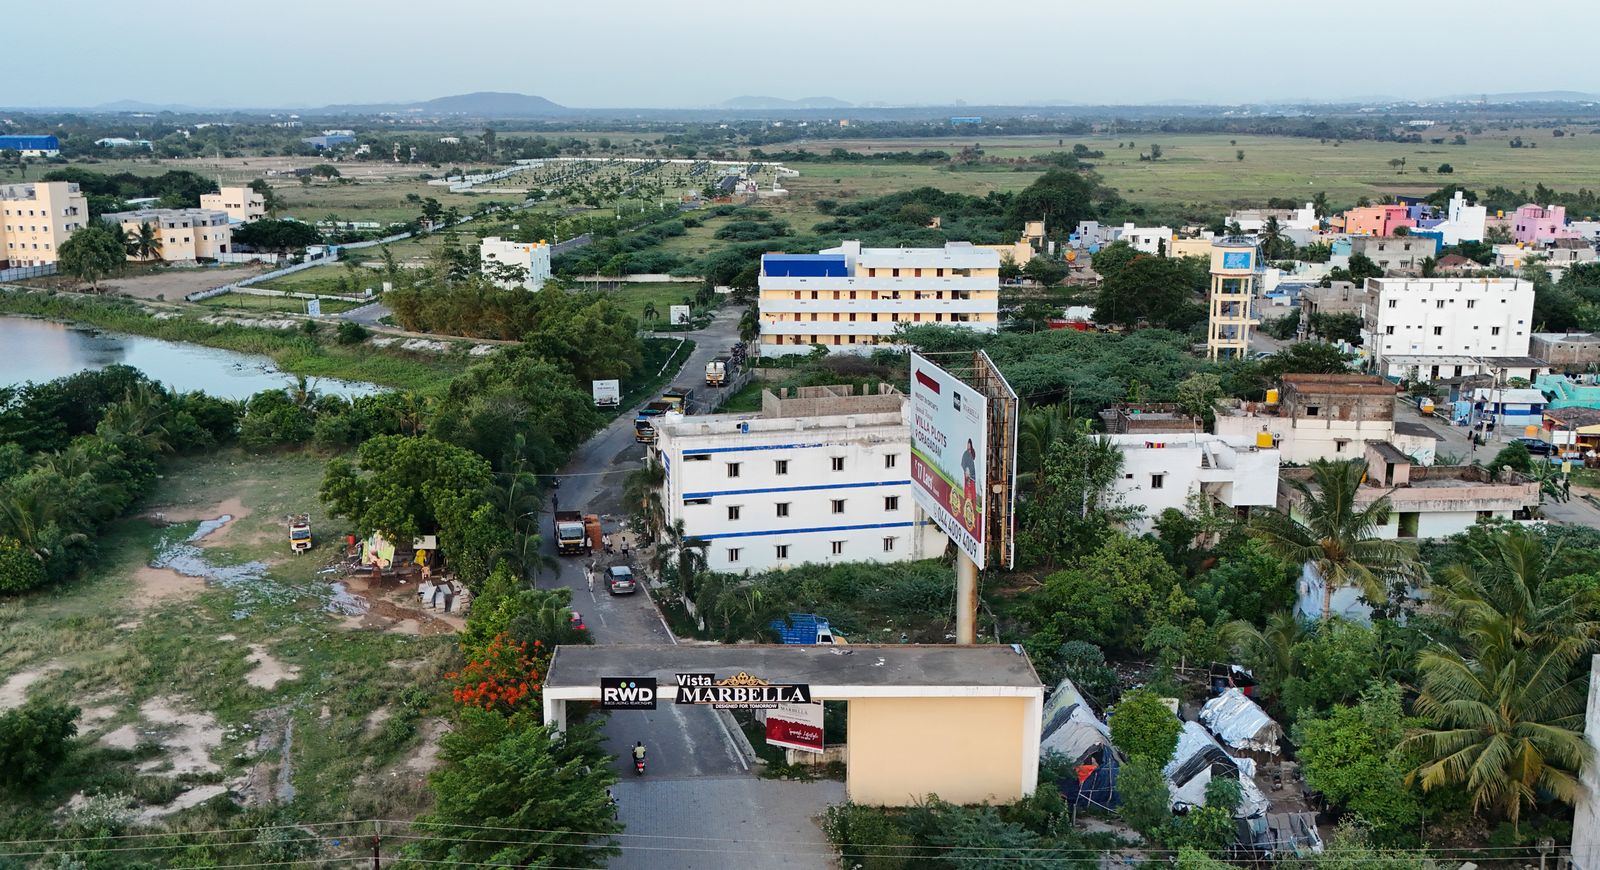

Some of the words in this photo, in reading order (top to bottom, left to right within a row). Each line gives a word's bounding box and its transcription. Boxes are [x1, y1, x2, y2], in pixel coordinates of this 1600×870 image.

[915, 413, 930, 434] VILLA
[931, 425, 947, 448] PLOTS
[948, 517, 962, 543] 4009
[962, 531, 977, 559] 4009
[676, 674, 712, 686] Vista
[604, 687, 653, 702] RWD
[681, 687, 806, 702] MARBELLA
